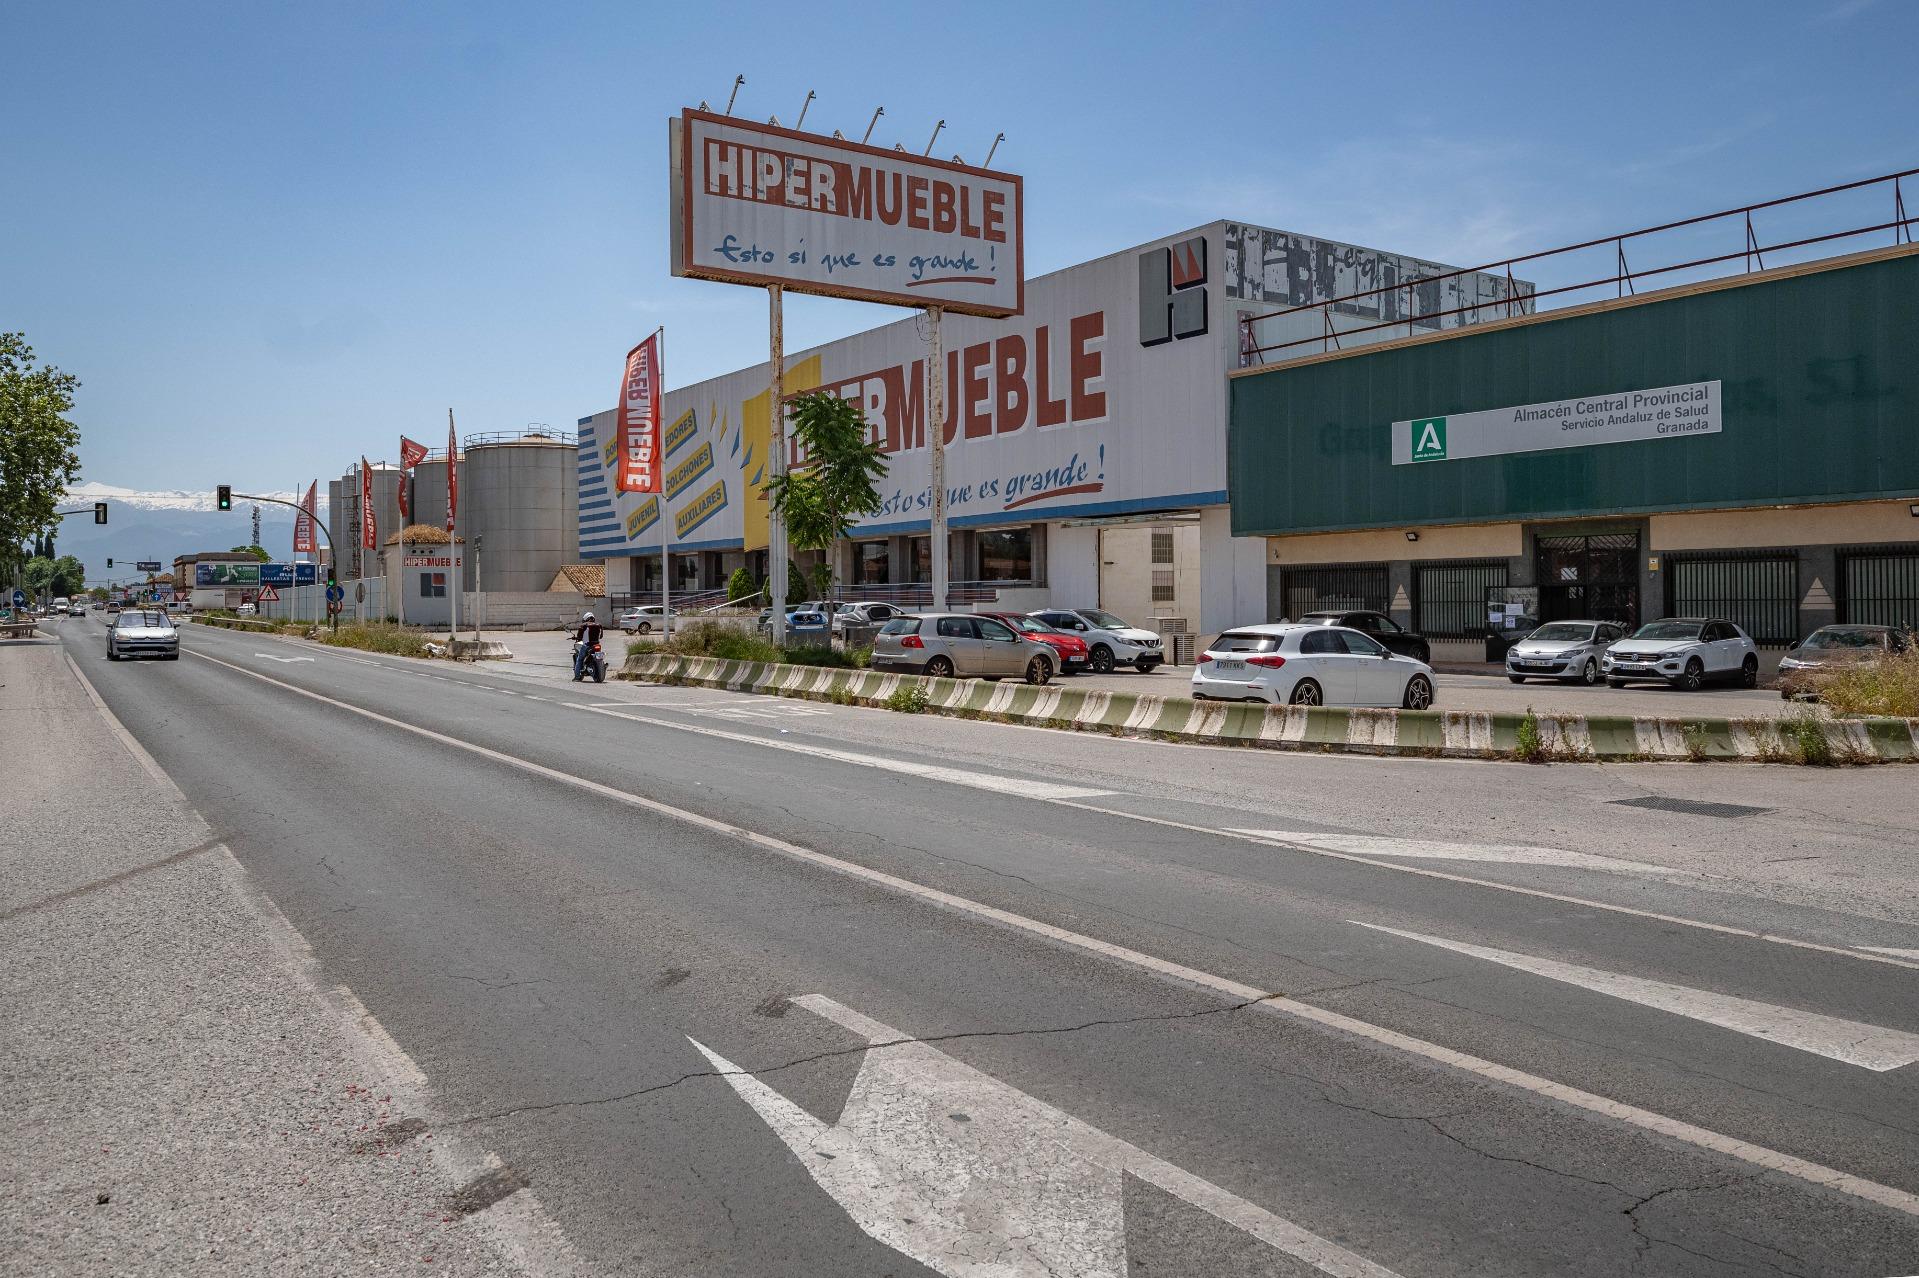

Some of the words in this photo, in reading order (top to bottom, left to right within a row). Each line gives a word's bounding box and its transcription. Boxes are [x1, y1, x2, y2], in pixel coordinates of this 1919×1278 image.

[705, 139, 1006, 243] HIPERMUEBLE
[713, 235, 775, 263] Esto
[821, 252, 861, 274] que
[872, 254, 896, 267] es
[1514, 404, 1571, 423] Almacén
[1576, 395, 1628, 415] Central
[1633, 386, 1708, 408] Provincial
[1561, 418, 1604, 431] Servicio
[1607, 413, 1653, 426] Andaluz
[1657, 408, 1671, 420] de
[1675, 404, 1709, 418] Salud
[1657, 420, 1709, 434] Granada
[666, 449, 709, 492] COLCHONES
[979, 478, 999, 499] es
[629, 502, 657, 531] JUVENIL
[678, 486, 722, 530] AUXILIARES
[404, 557, 462, 567] HIPERMUEBE
